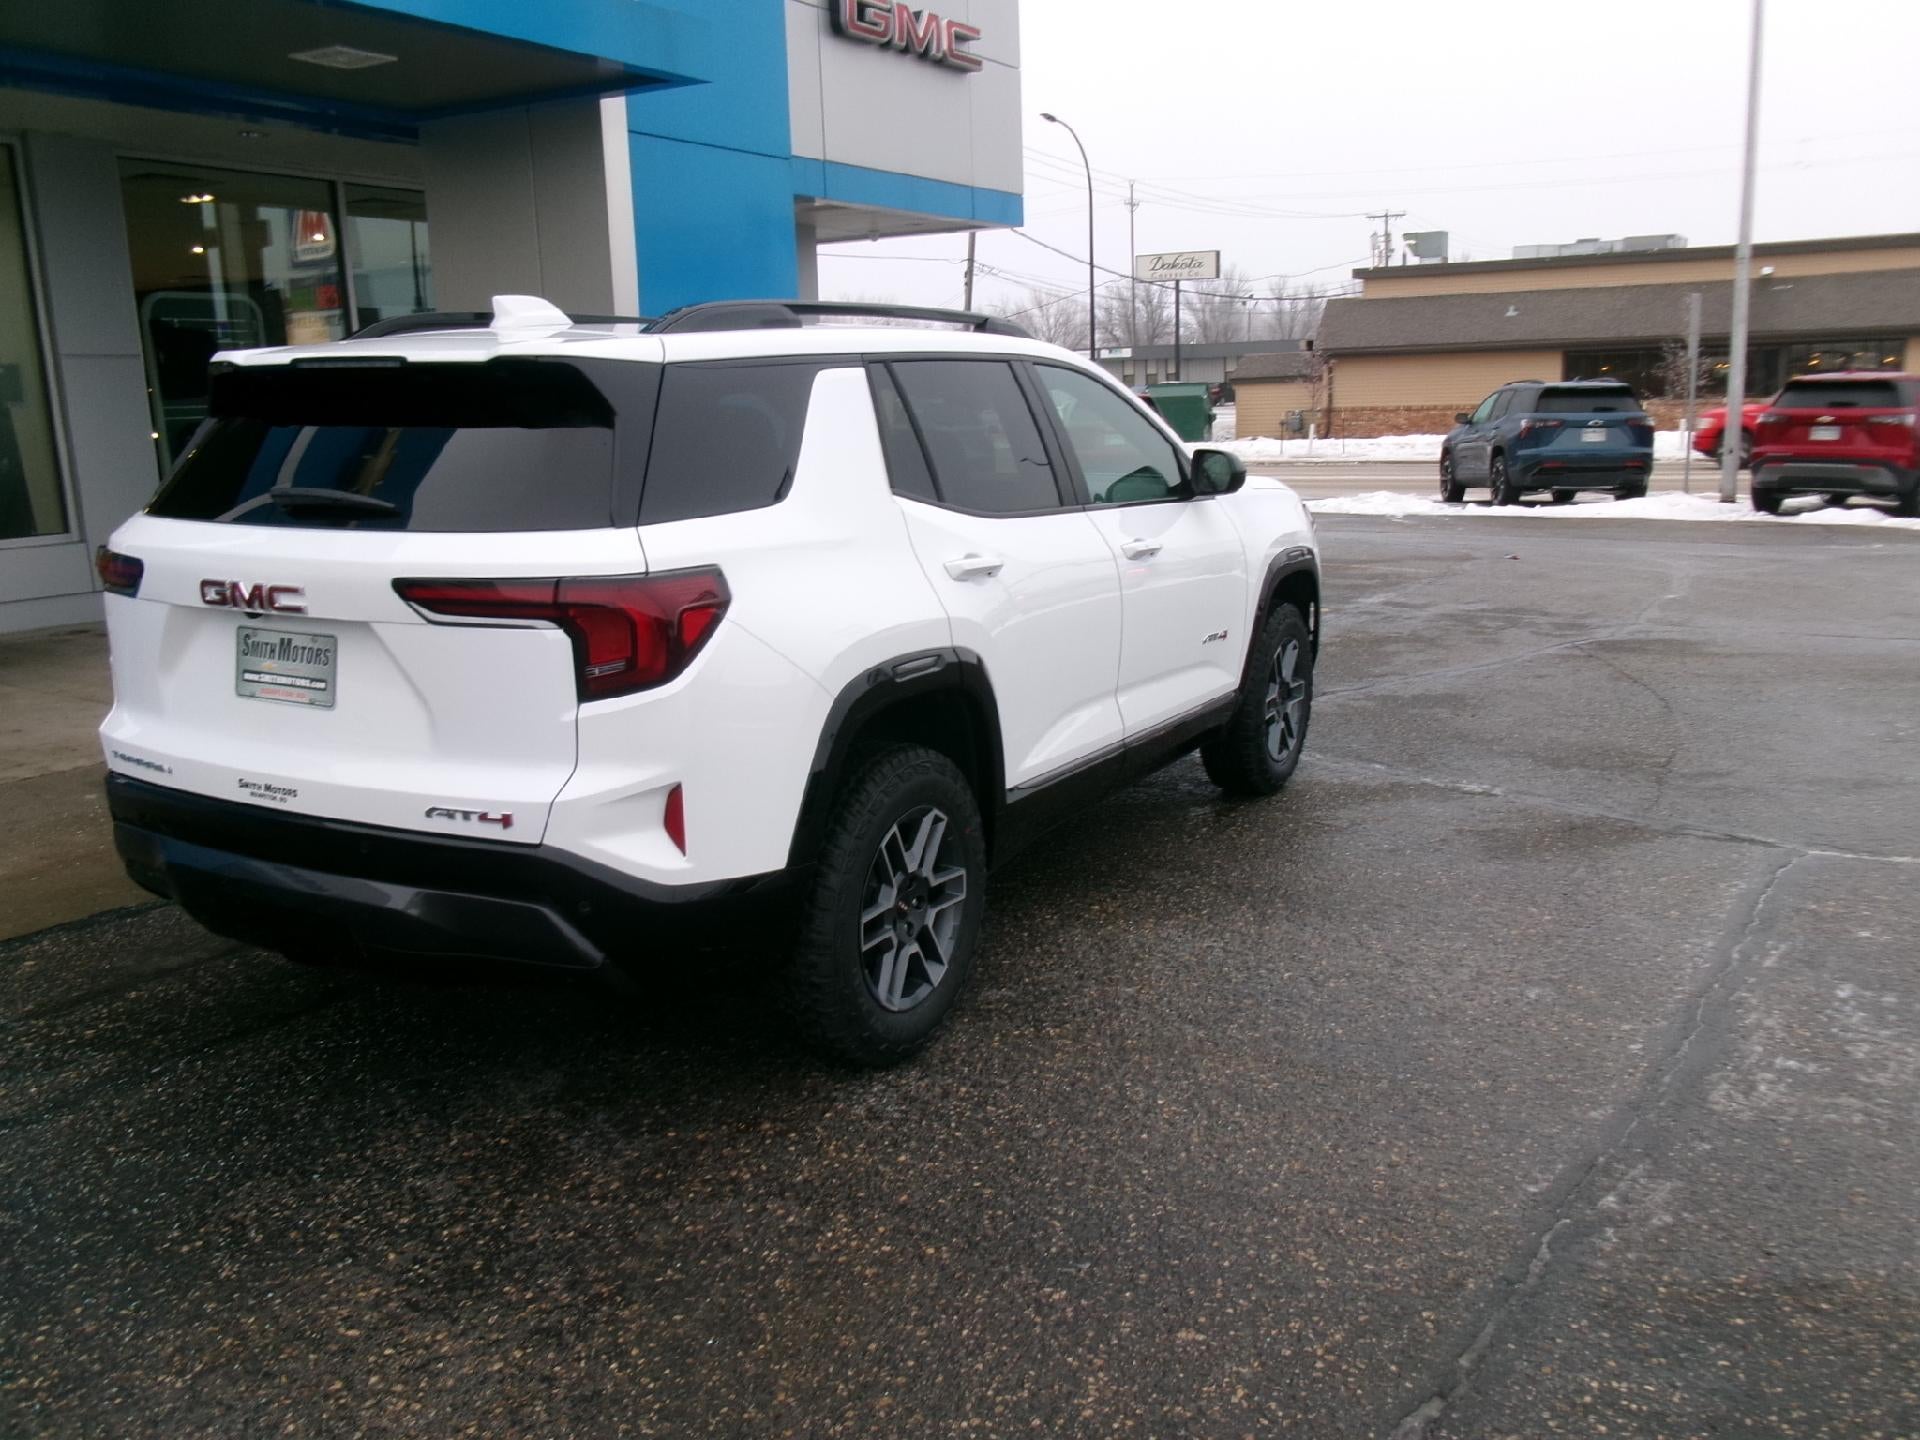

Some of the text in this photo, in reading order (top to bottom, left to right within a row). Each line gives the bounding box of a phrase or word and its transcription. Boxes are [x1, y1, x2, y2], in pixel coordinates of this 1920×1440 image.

[840, 0, 983, 72] GMC
[1148, 255, 1205, 272] Dakota
[200, 578, 308, 615] GMC
[425, 806, 513, 830] AT4
